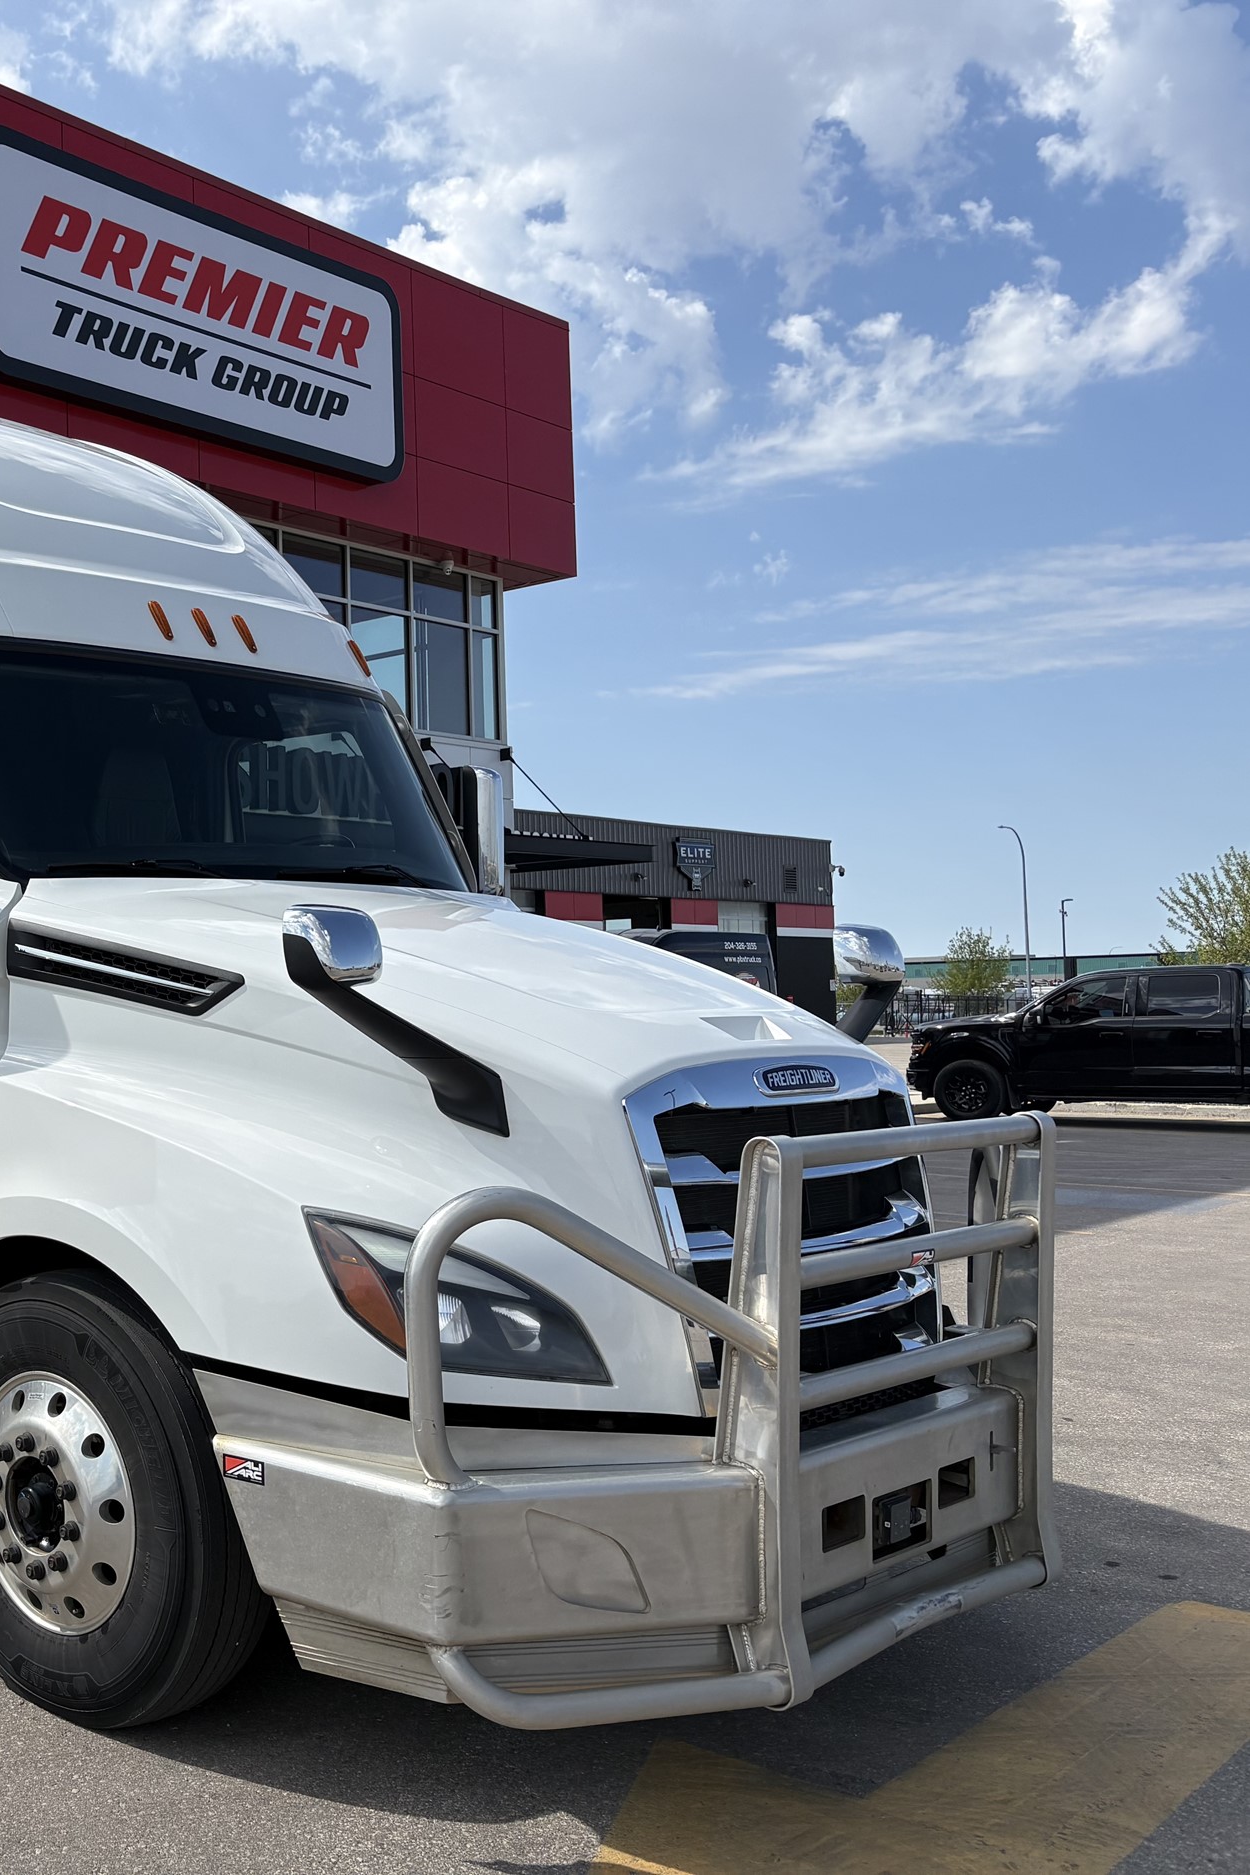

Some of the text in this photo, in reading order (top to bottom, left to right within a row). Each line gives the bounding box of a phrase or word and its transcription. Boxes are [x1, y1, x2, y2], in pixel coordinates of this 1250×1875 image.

[20, 195, 370, 368] PREMIER
[51, 300, 349, 421] TRUCK GROUP
[680, 847, 711, 858] ELITE
[767, 1069, 833, 1087] FREIGHTLINER
[232, 1468, 262, 1480] ARC
